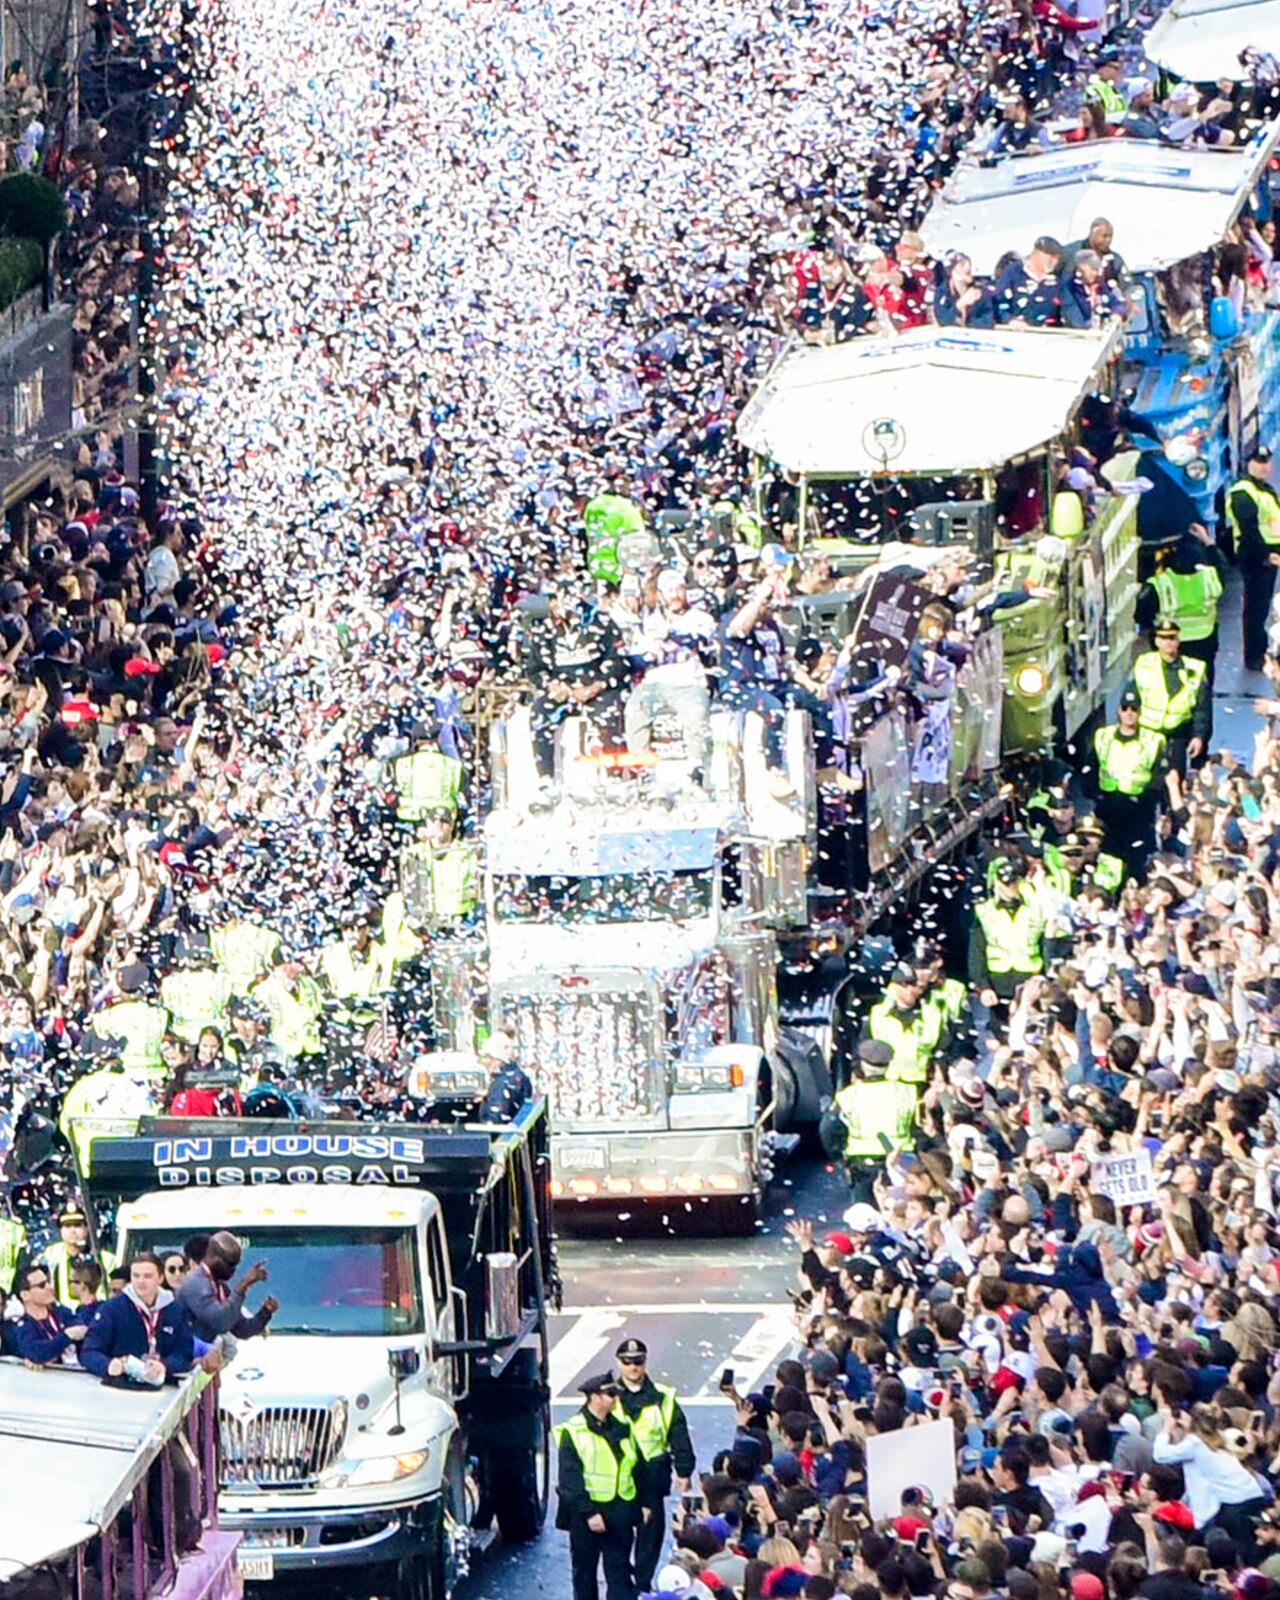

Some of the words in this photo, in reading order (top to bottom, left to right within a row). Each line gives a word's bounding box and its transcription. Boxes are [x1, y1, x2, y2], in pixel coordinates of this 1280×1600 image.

[153, 1137, 212, 1165] IN
[230, 1135, 424, 1163] HOUSE
[158, 1165, 420, 1185] DISPOSAL
